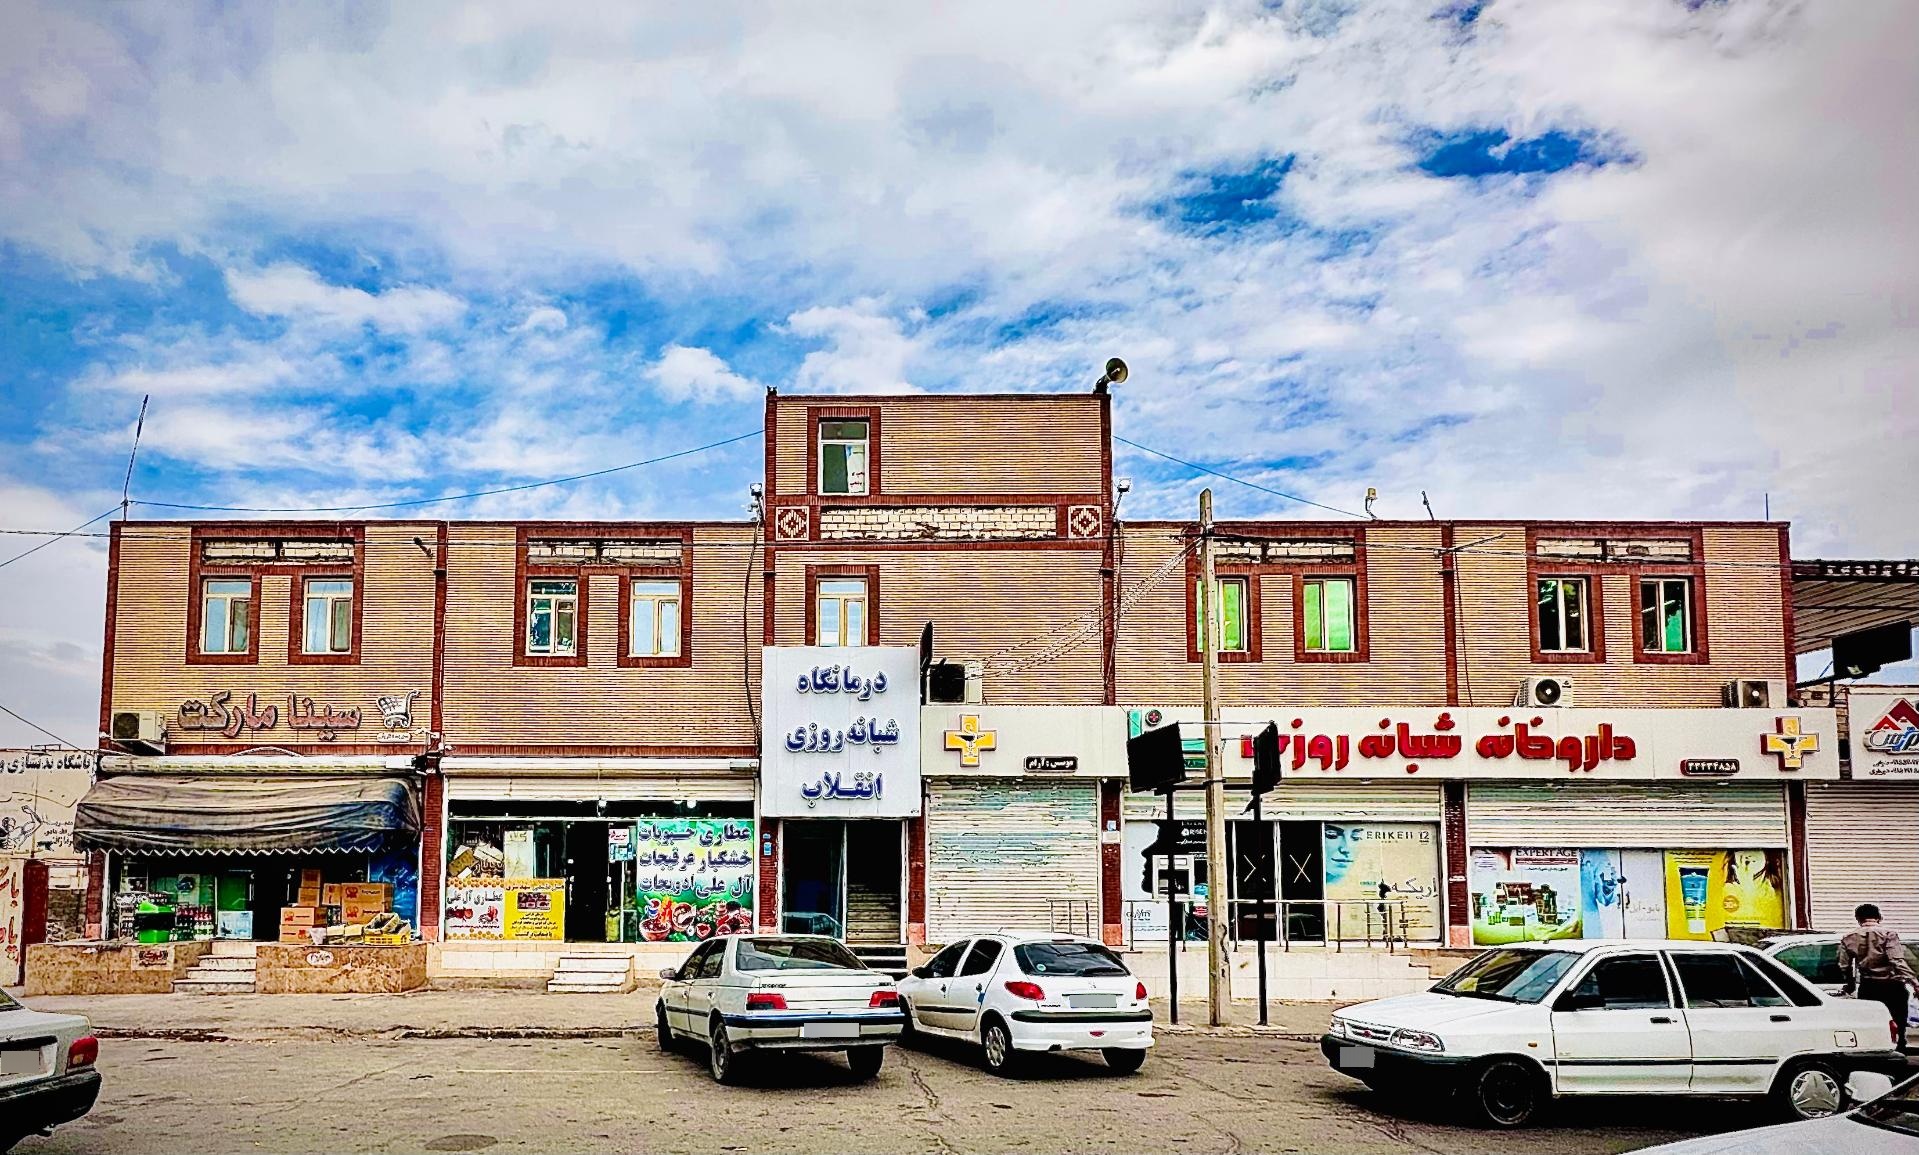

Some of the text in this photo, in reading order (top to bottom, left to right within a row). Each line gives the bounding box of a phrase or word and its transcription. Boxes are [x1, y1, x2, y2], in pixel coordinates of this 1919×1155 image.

[796, 665, 888, 700] درمانگاه
[177, 689, 362, 741] سینا مارکت
[785, 716, 900, 754] شبانه روزی
[1358, 712, 1462, 774] شبانه
[1475, 715, 1637, 773] داروخانه
[801, 771, 884, 808] انقلاب
[638, 823, 697, 846] حبوبات
[699, 823, 752, 847] عطاری
[639, 847, 753, 873] خشکبار عرقیجات
[473, 891, 504, 905] عطاری
[695, 876, 727, 899] علی
[731, 873, 753, 898] آل
